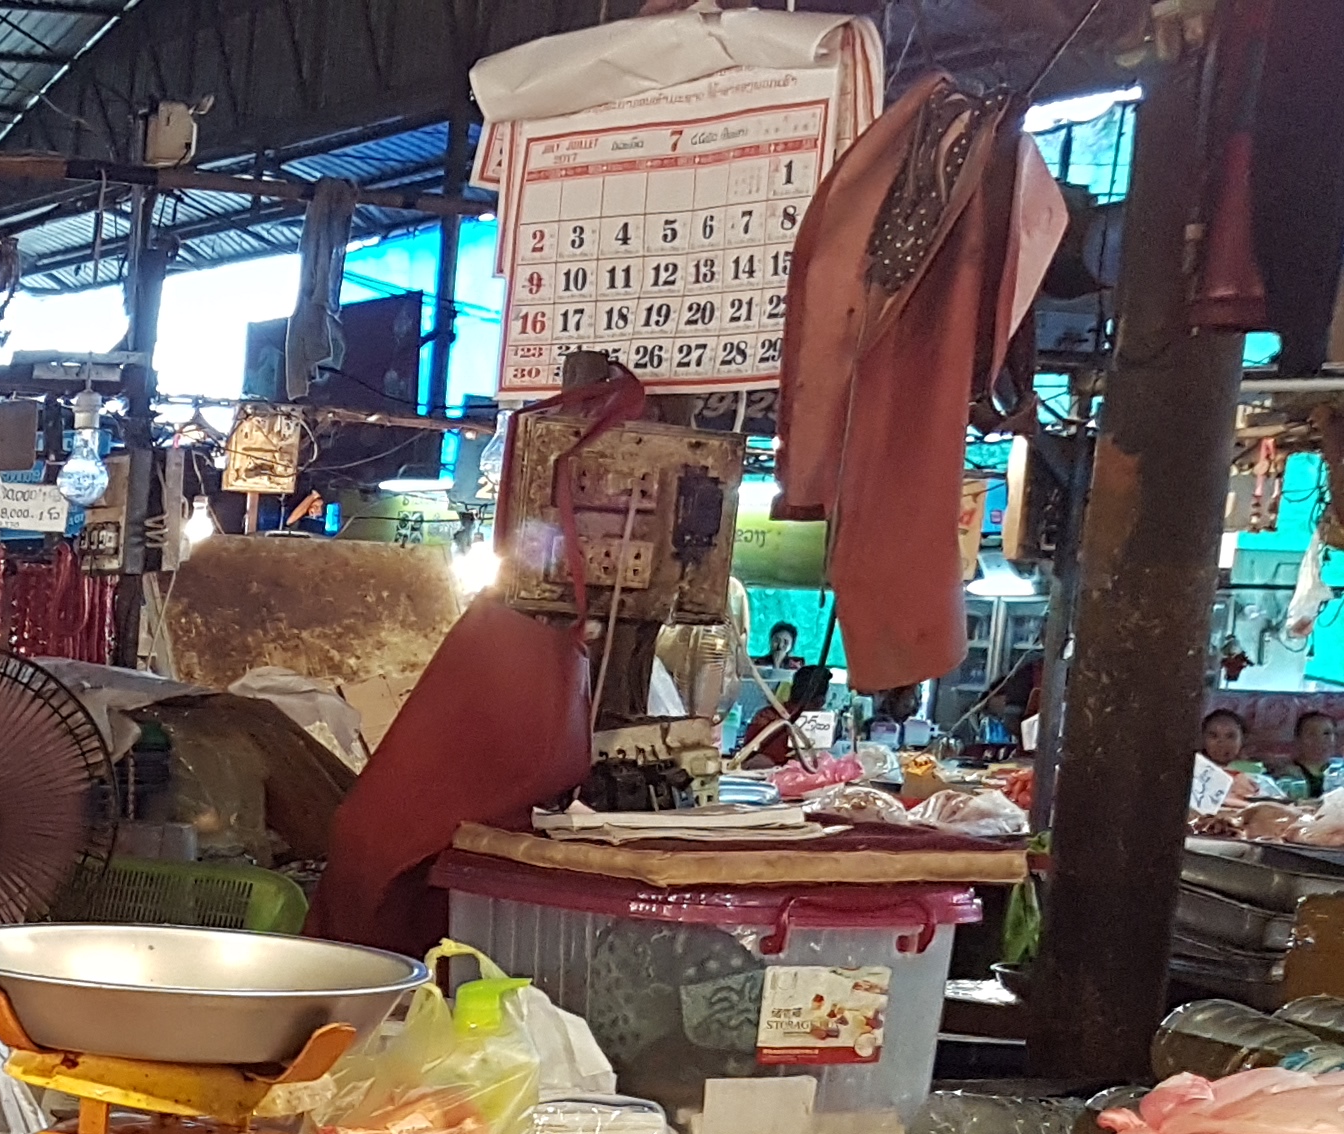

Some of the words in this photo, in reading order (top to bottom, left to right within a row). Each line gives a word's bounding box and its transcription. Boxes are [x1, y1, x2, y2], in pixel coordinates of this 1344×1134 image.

[669, 130, 684, 152] 7
[782, 159, 794, 186] 1
[531, 229, 545, 253] 2
[570, 225, 585, 250] 3
[614, 222, 632, 246] 4
[662, 218, 678, 244] 5
[702, 214, 715, 240] 6
[741, 209, 754, 235] 7
[781, 204, 799, 231] 8
[527, 271, 544, 295] 9
[562, 267, 588, 292] 10
[606, 264, 632, 290] 11
[650, 262, 679, 288] 12
[692, 258, 716, 284] 13
[732, 254, 756, 281] 14
[518, 310, 547, 335] 16
[559, 307, 586, 333] 17
[603, 305, 630, 331] 18
[640, 303, 672, 328] 19
[684, 300, 716, 326] 20
[728, 296, 755, 323] 21
[633, 344, 664, 370] 26
[676, 342, 708, 369] 27
[719, 339, 749, 366] 28
